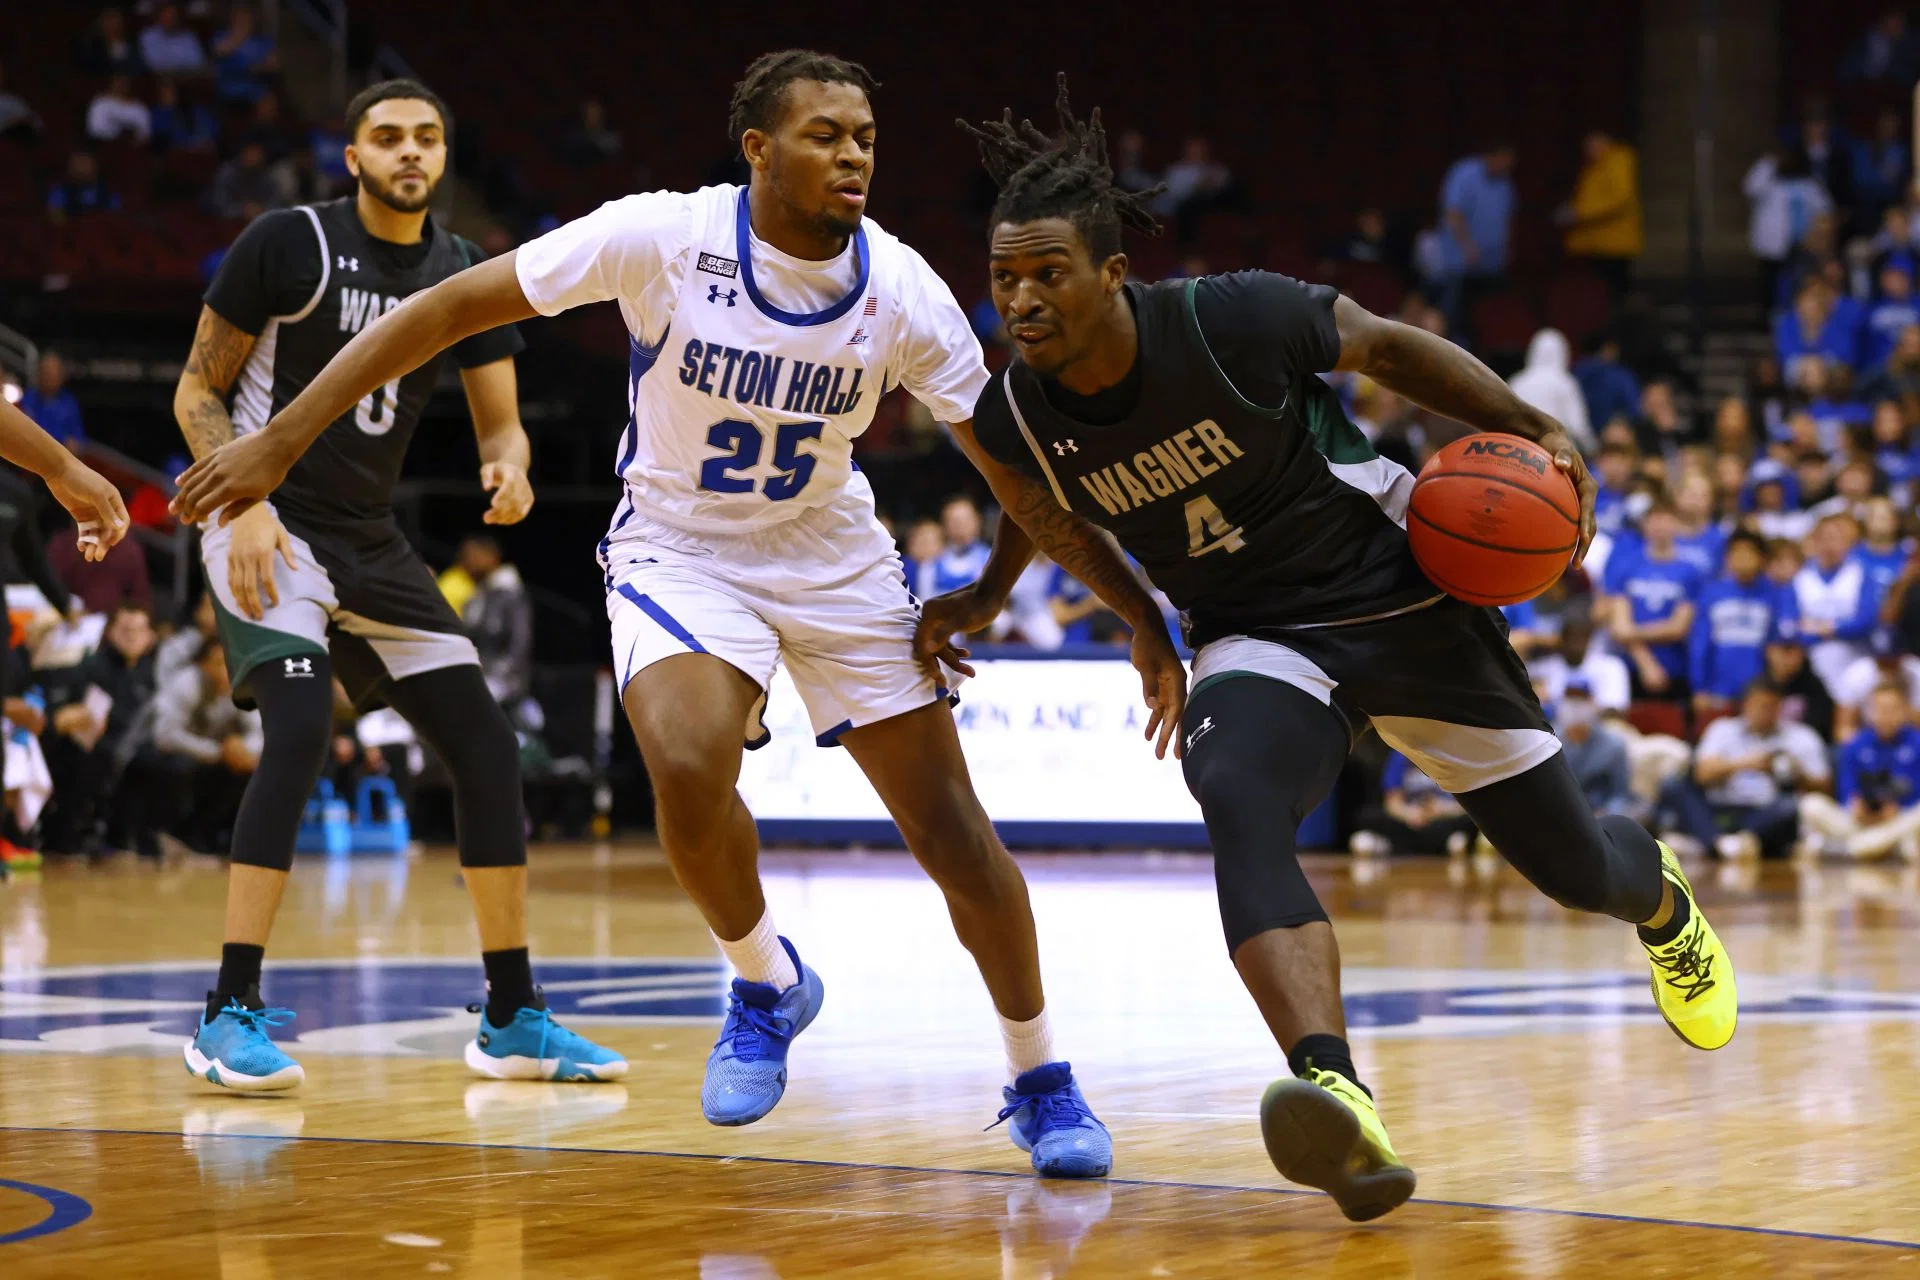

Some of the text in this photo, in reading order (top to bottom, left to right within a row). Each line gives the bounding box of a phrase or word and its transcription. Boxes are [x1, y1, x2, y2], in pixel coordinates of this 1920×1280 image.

[698, 262, 736, 277] CHANGE
[679, 338, 864, 416] SETON HALL
[700, 416, 825, 502] 25
[1078, 418, 1246, 517] WAGNER
[1463, 441, 1550, 476] NCAA
[1184, 494, 1248, 558] 4
